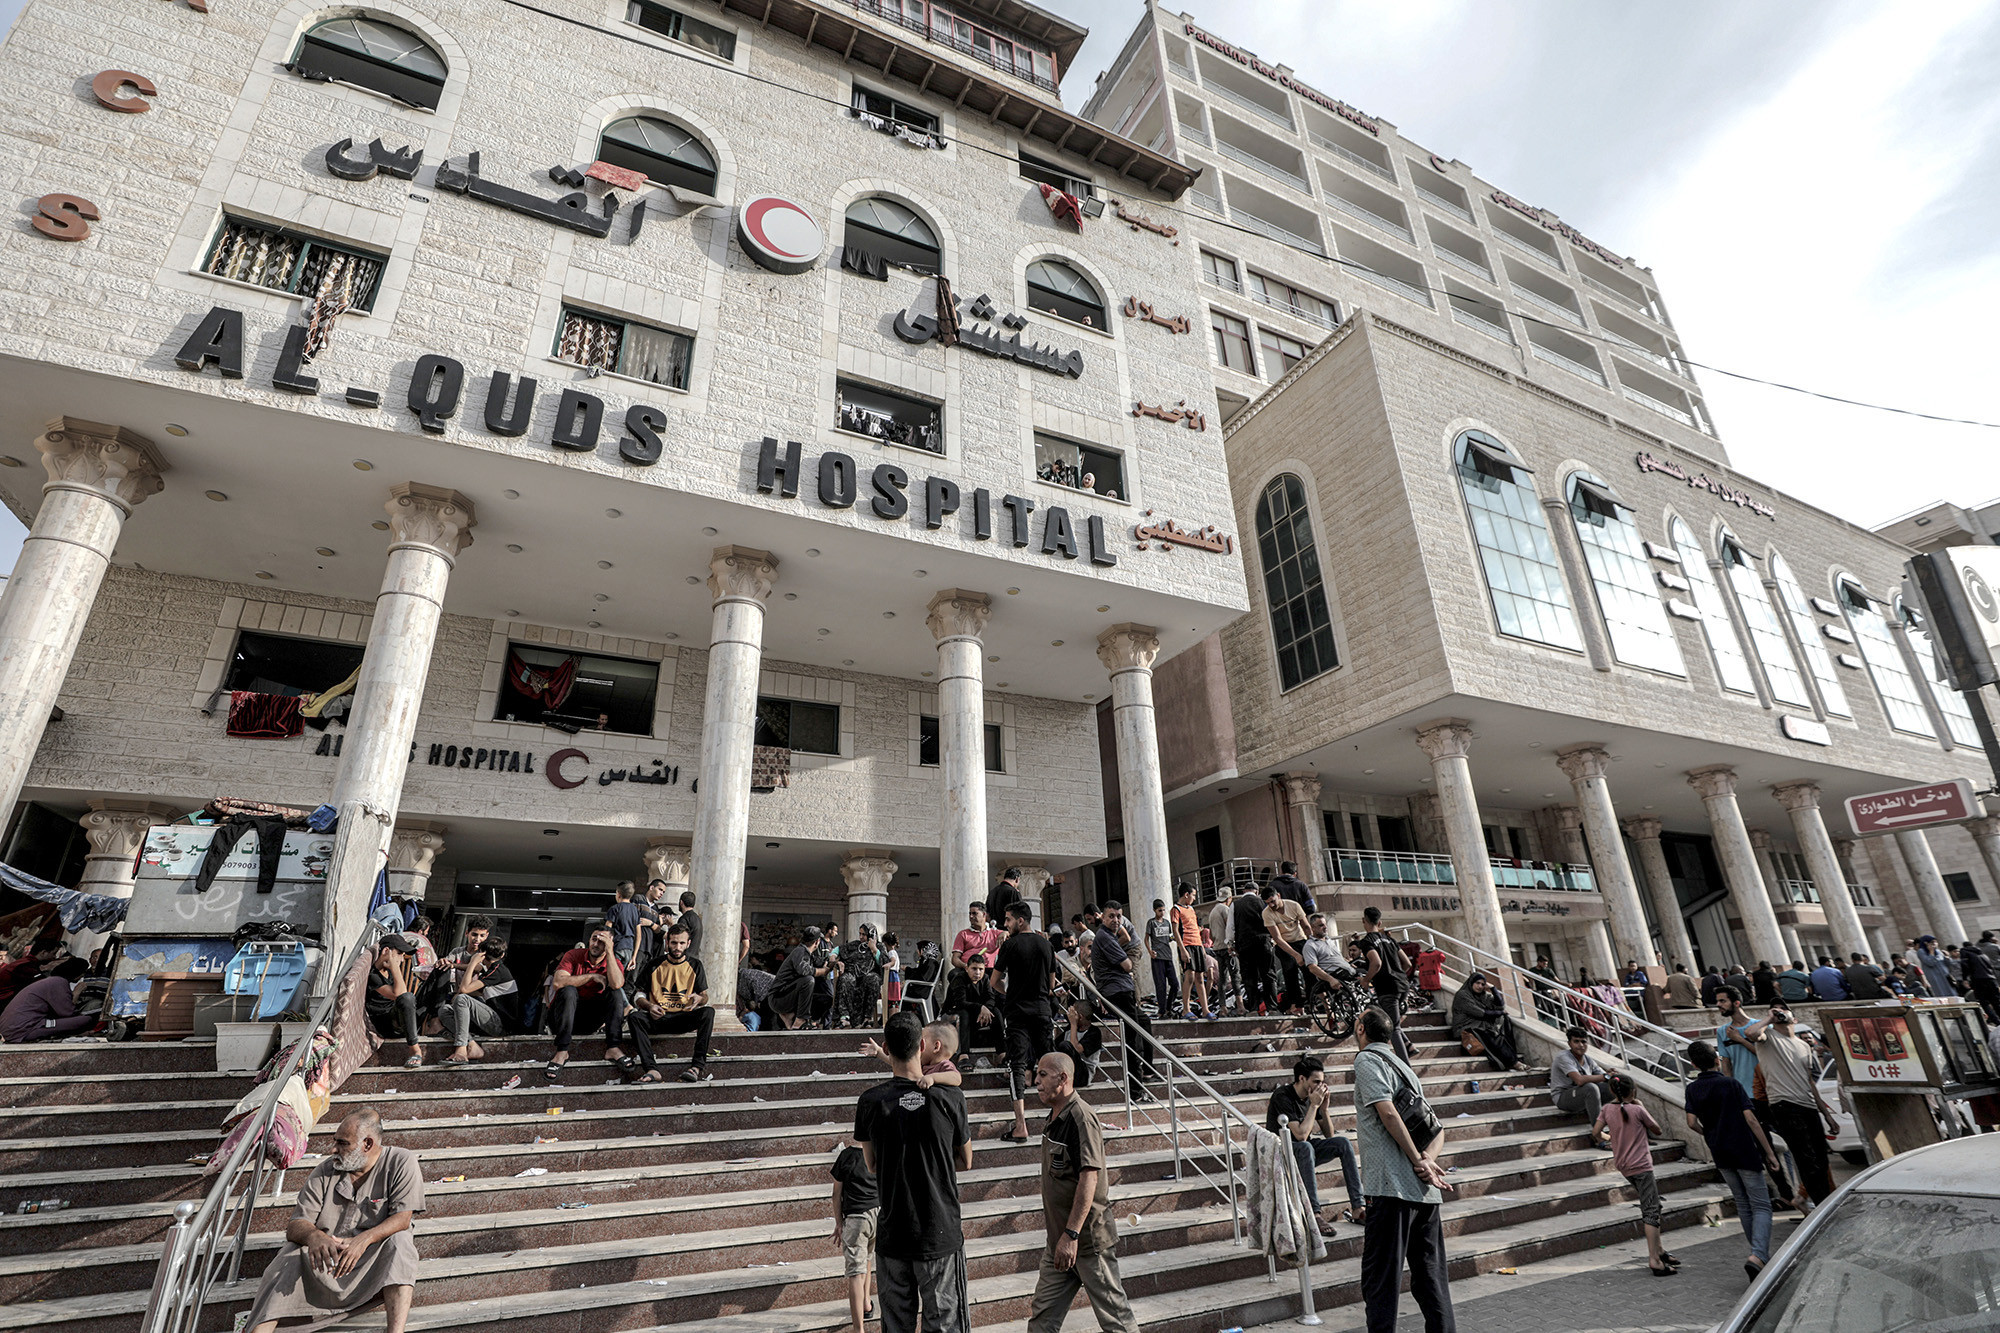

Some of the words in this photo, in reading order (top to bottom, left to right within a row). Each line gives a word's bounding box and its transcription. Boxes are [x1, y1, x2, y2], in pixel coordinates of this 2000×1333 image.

[1185, 23, 1249, 65] Palestine
[1251, 58, 1277, 81] Red
[1279, 74, 1336, 112] Crescent
[1336, 104, 1380, 137] Society
[325, 137, 646, 247] القدس
[1111, 198, 1180, 247] جمعية
[1124, 295, 1192, 335] الهلال
[1636, 450, 1687, 481] الفلسطيني
[756, 436, 1118, 568] HOSPITAL
[1134, 508, 1234, 555] الفلسطيني
[429, 743, 534, 774] HOSPITAL
[599, 757, 679, 787] القدس
[1908, 790, 1953, 808] مدخل
[1392, 896, 1462, 911] PHARMAC
